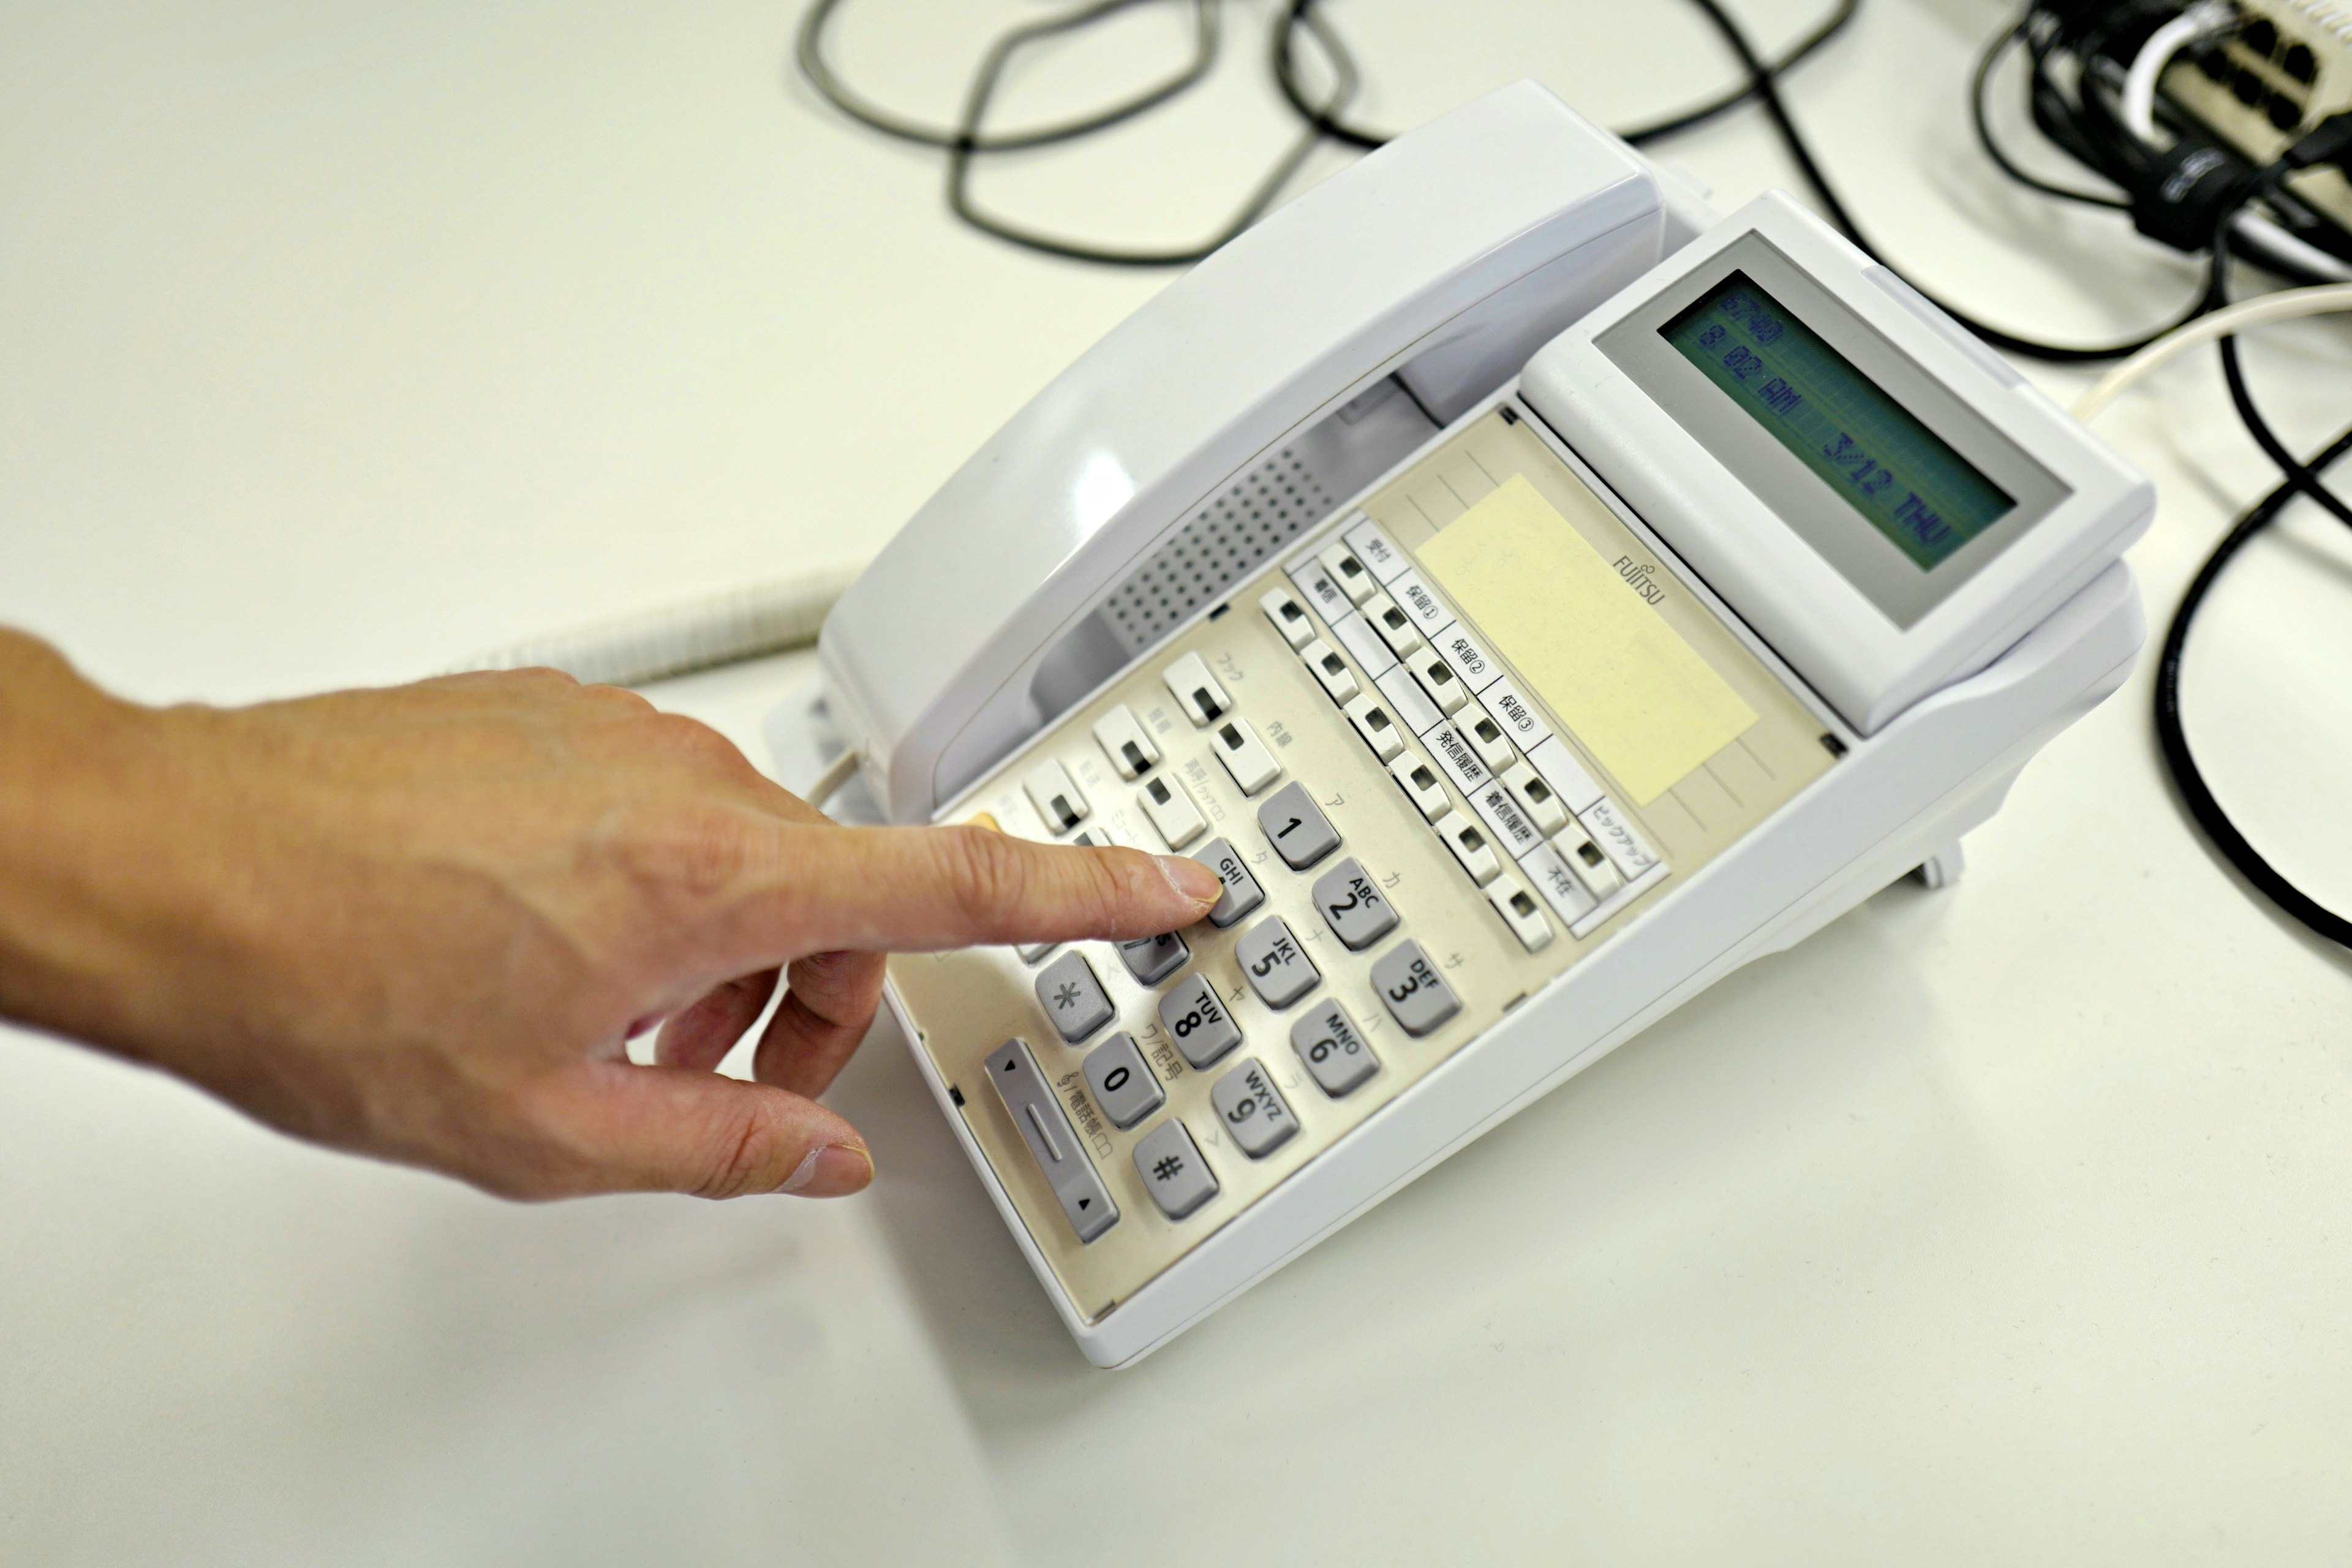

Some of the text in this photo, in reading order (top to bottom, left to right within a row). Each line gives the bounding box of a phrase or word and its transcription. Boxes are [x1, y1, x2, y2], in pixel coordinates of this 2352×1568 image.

[1700, 324, 1726, 346] 8
[1757, 377, 1802, 415] AM
[1823, 431, 1893, 495] 3/12
[1894, 492, 1951, 544] THU
[1365, 538, 1392, 563] 受付
[1613, 554, 1665, 605] FUJITSU
[1406, 585, 1439, 619] 保留①
[1451, 638, 1485, 674] 保留②
[1499, 695, 1534, 732] 保留③
[1266, 720, 1292, 748] 内線
[1436, 729, 1483, 783] 発信履歴
[1325, 792, 1344, 807] ア
[1277, 817, 1302, 839] 1
[1485, 790, 1533, 846] 着信履歴
[1219, 858, 1244, 886] GHI
[1382, 871, 1401, 889] カ
[1548, 865, 1573, 898] 不在
[1329, 892, 1359, 921] 2
[1349, 877, 1379, 909] ABC
[1251, 951, 1282, 978] 5
[1273, 937, 1298, 966] JKL
[1410, 958, 1440, 990] DEF
[1389, 976, 1420, 1003] 3
[1195, 990, 1223, 1025] TUV
[1175, 1011, 1202, 1038] 8
[1325, 1012, 1360, 1055] MNO
[1310, 1038, 1338, 1064] 6
[1104, 1067, 1129, 1091] 0
[1245, 1069, 1283, 1122] WXYZ
[1227, 1098, 1257, 1124] 9
